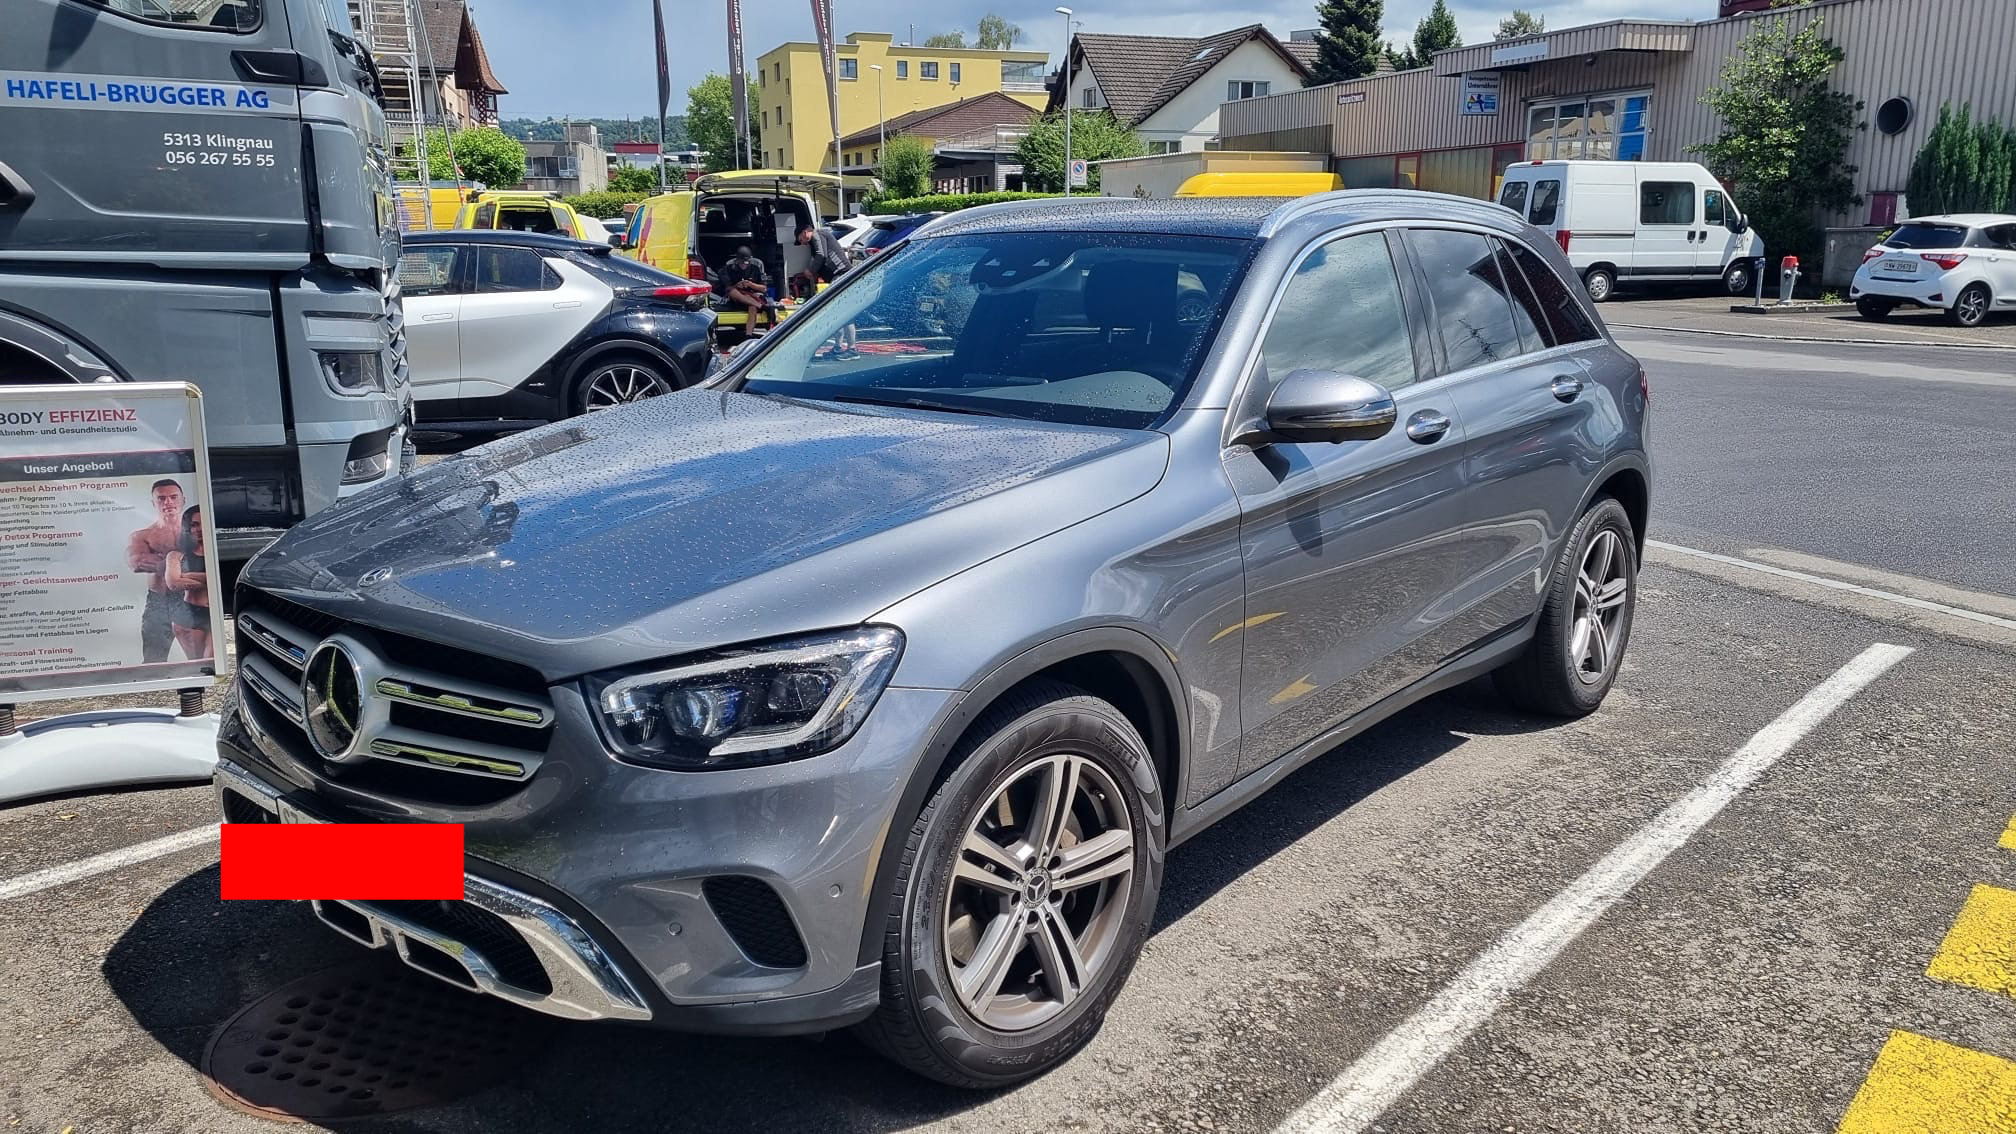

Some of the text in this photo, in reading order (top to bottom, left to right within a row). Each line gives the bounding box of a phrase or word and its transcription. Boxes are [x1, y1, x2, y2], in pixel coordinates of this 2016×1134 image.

[7, 79, 269, 108] HÄFELI-BRÜGGER AG
[163, 133, 273, 151] 5313 Klingnau
[165, 151, 275, 167] 056 267 55 55
[0, 409, 137, 425] BODY EFFIZIENZ
[0, 428, 38, 436] Abnehm-
[59, 425, 138, 435] Gesundheitsstudio
[24, 461, 114, 474] Unser Angebot!
[38, 483, 78, 492] Abnehm
[80, 481, 128, 490] Programm
[32, 531, 83, 540] Programme
[22, 574, 119, 585] Gesichtsanwendungen
[40, 609, 76, 617] Anti-Aging
[38, 647, 73, 656] Training
